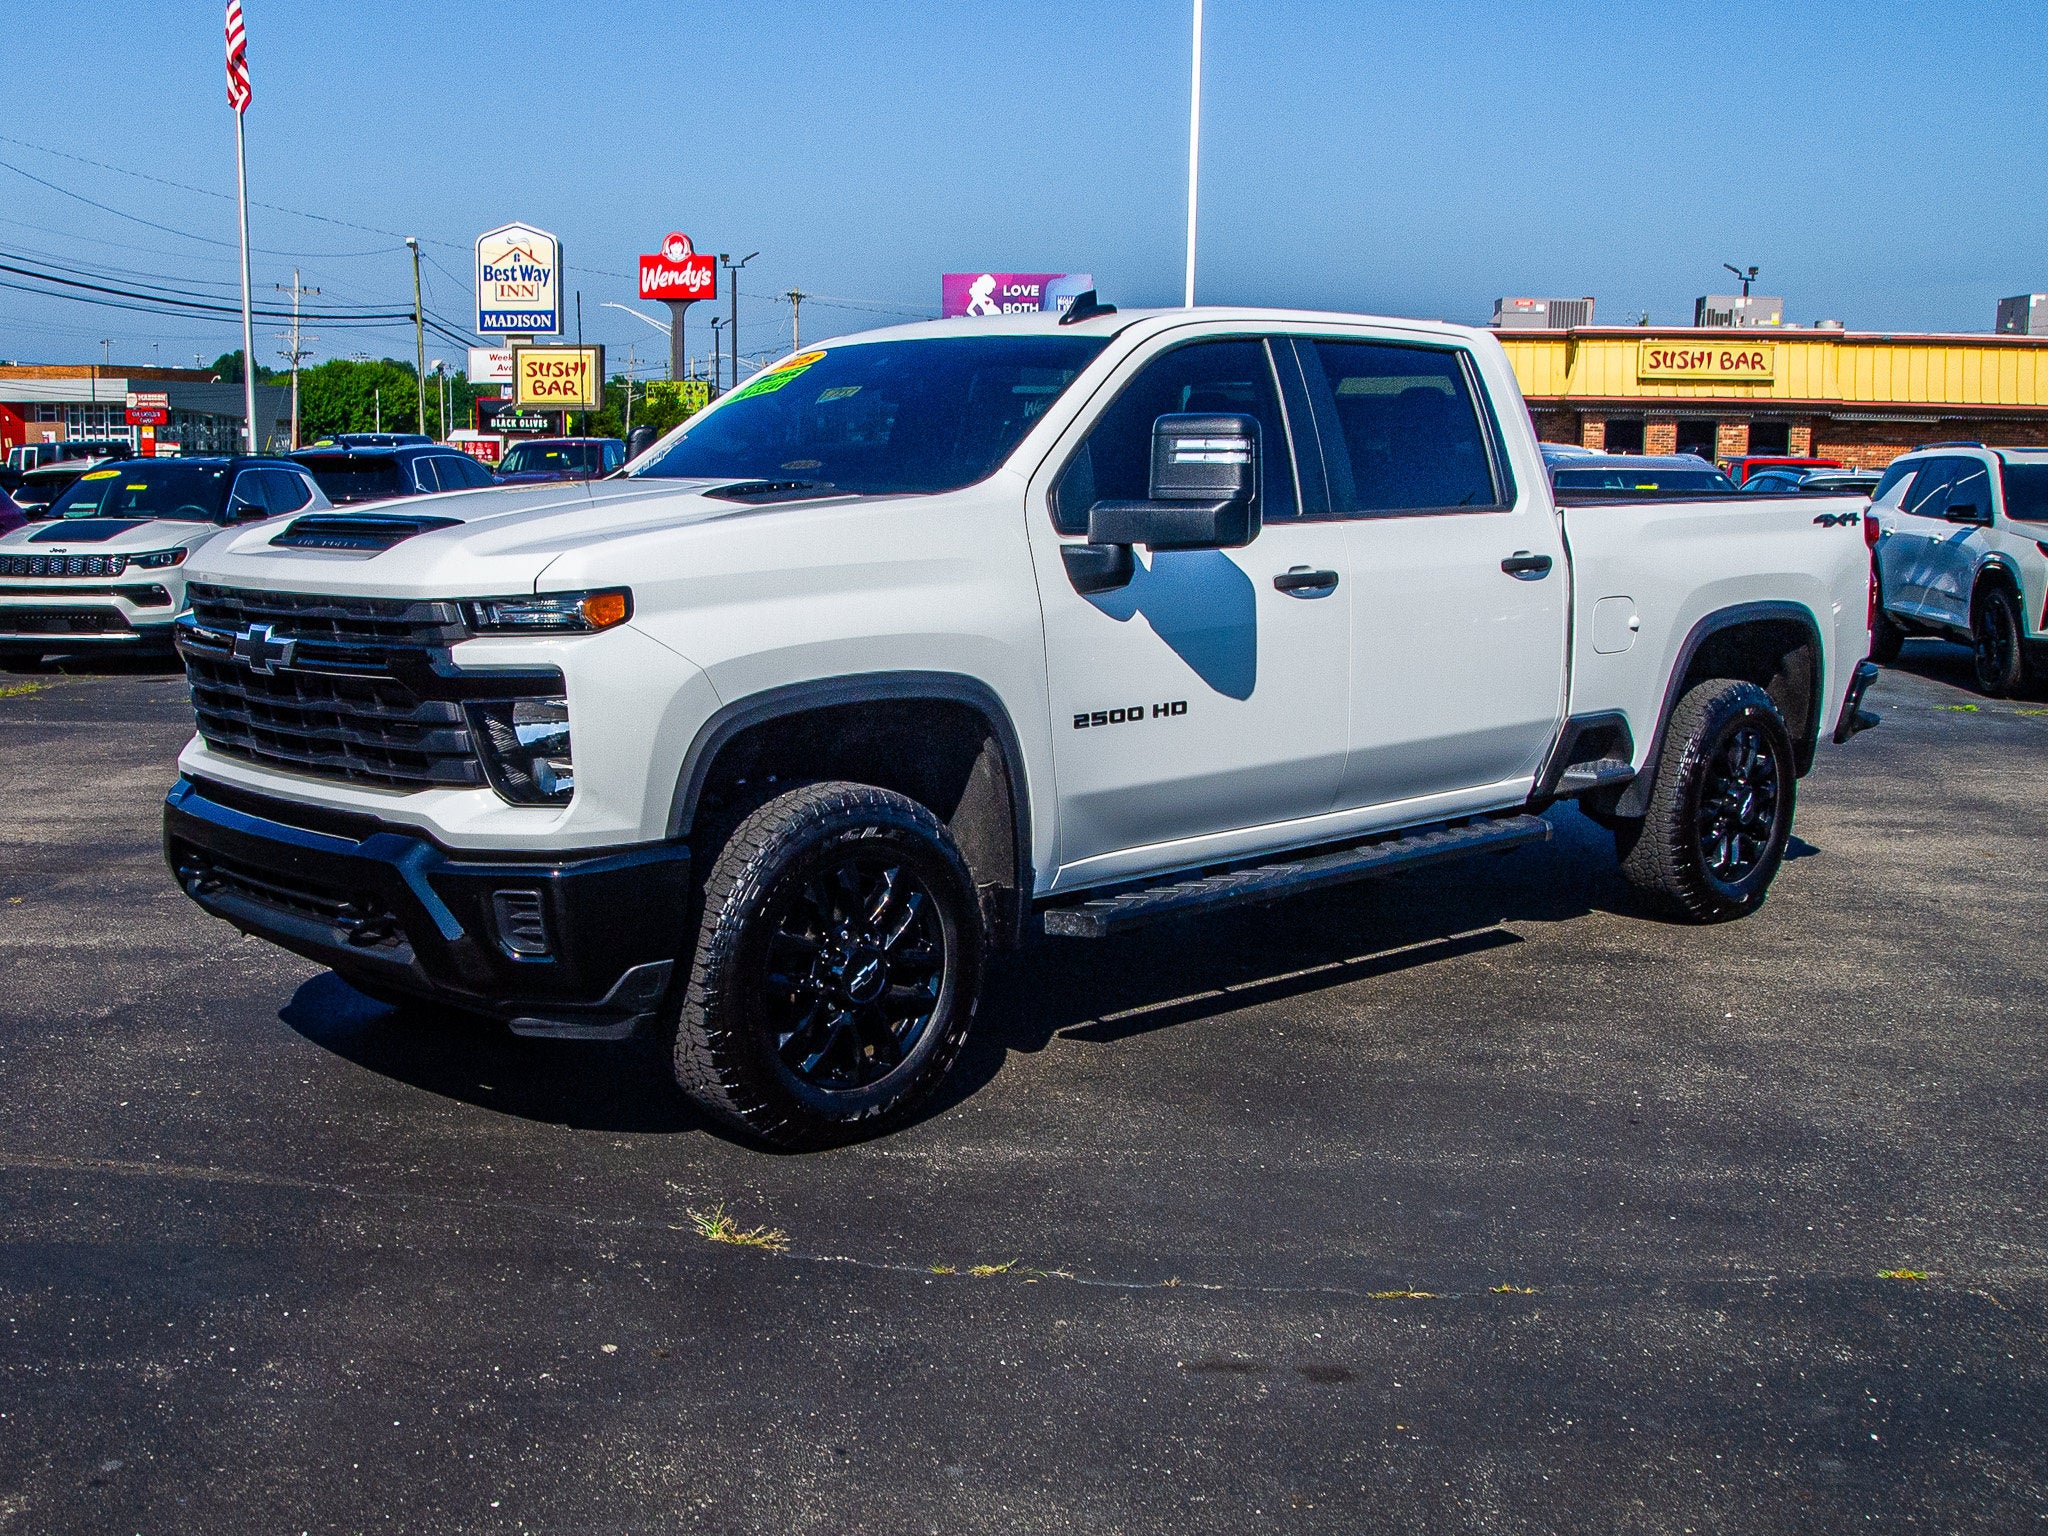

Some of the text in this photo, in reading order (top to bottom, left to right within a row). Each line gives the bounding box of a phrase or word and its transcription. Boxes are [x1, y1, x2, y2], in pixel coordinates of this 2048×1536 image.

[483, 265, 551, 287] Best Way
[642, 261, 711, 293] Wendy's
[500, 284, 534, 297] INN
[1002, 284, 1040, 297] LOVE
[1002, 302, 1040, 314] BOTH
[483, 314, 552, 328] MADISON
[1648, 350, 1767, 371] SUSHI BAR
[526, 361, 586, 396] SUSHI BAR
[490, 418, 549, 428] BLACK OLIVES
[1073, 700, 1188, 730] 2500 HD
